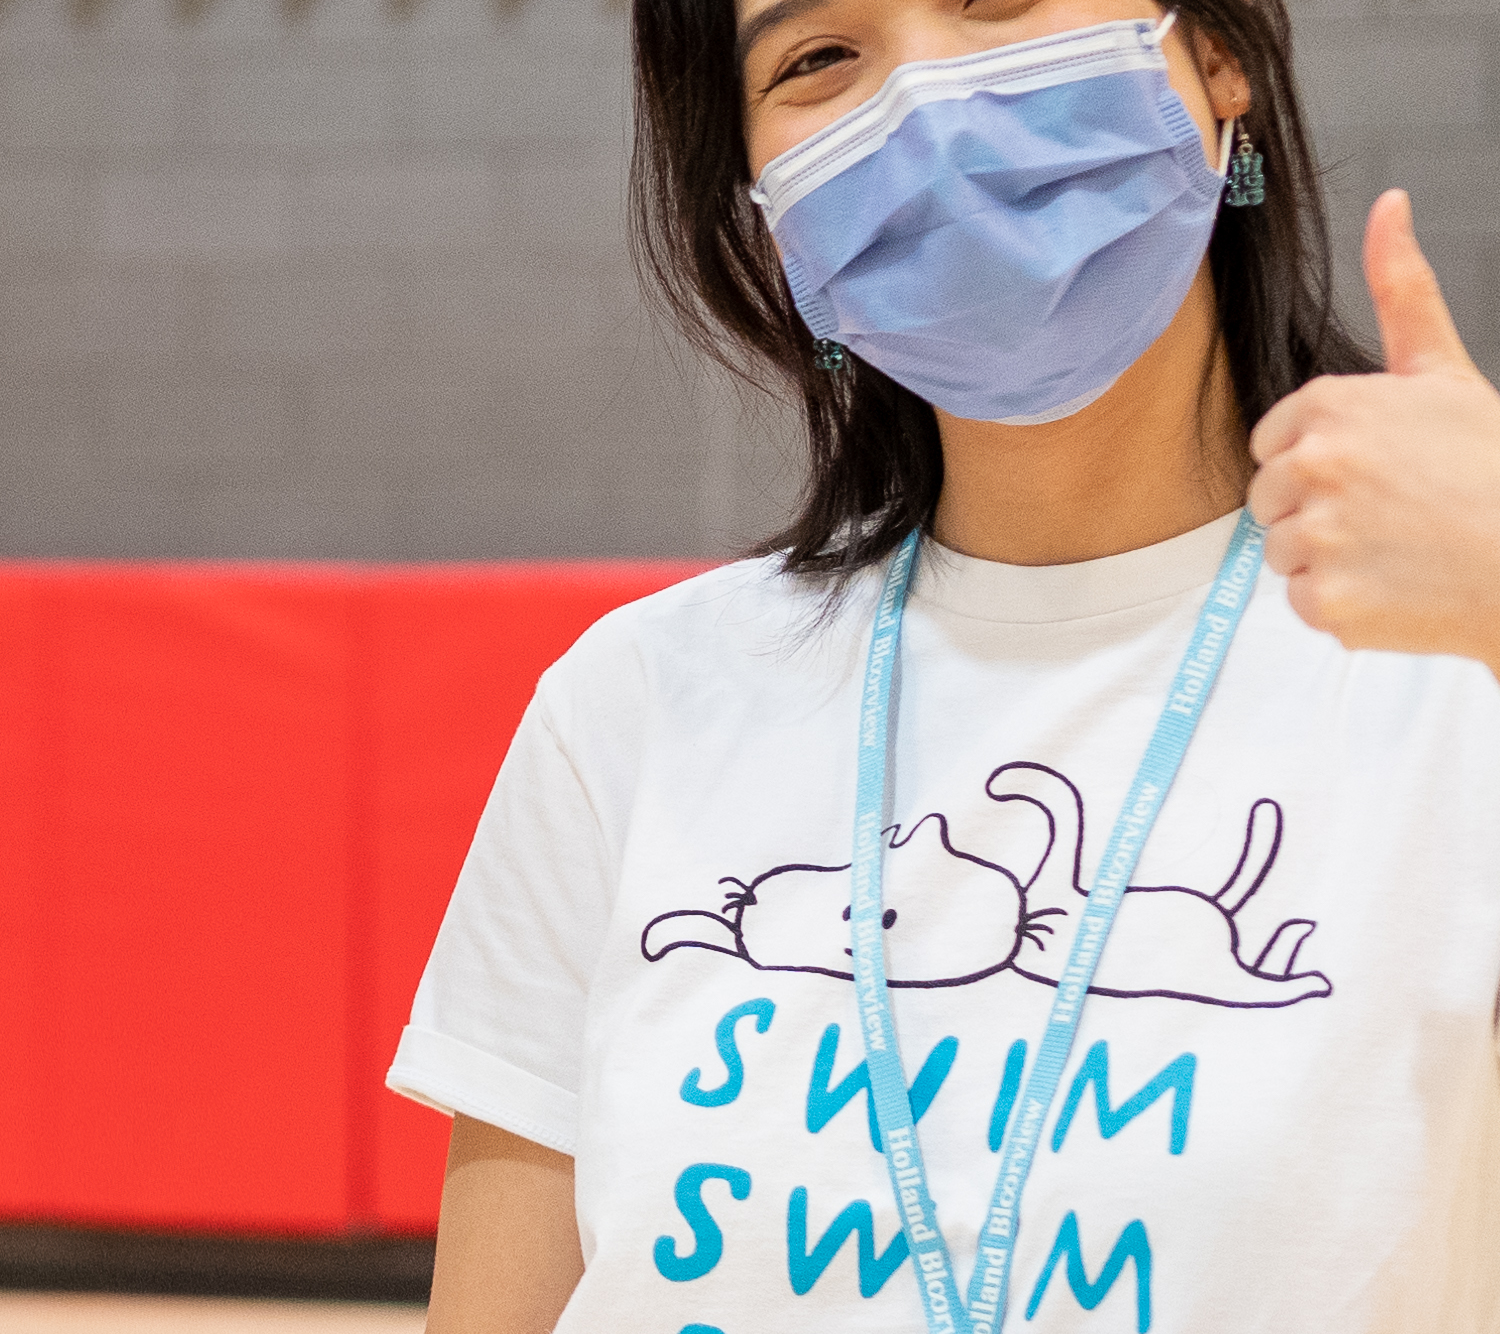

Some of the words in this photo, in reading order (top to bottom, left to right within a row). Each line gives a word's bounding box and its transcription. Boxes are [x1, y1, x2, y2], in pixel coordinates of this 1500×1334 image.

[863, 634, 893, 748] Bloorview
[1168, 612, 1232, 716] Holland
[855, 811, 877, 914] Holland
[1052, 914, 1106, 1024] Holland
[1092, 780, 1161, 907] Bloorview
[856, 917, 887, 1053] Bloorview
[679, 997, 1198, 1156] SWIM
[886, 1126, 938, 1244] Holland
[988, 1097, 1043, 1238] Bloorview
